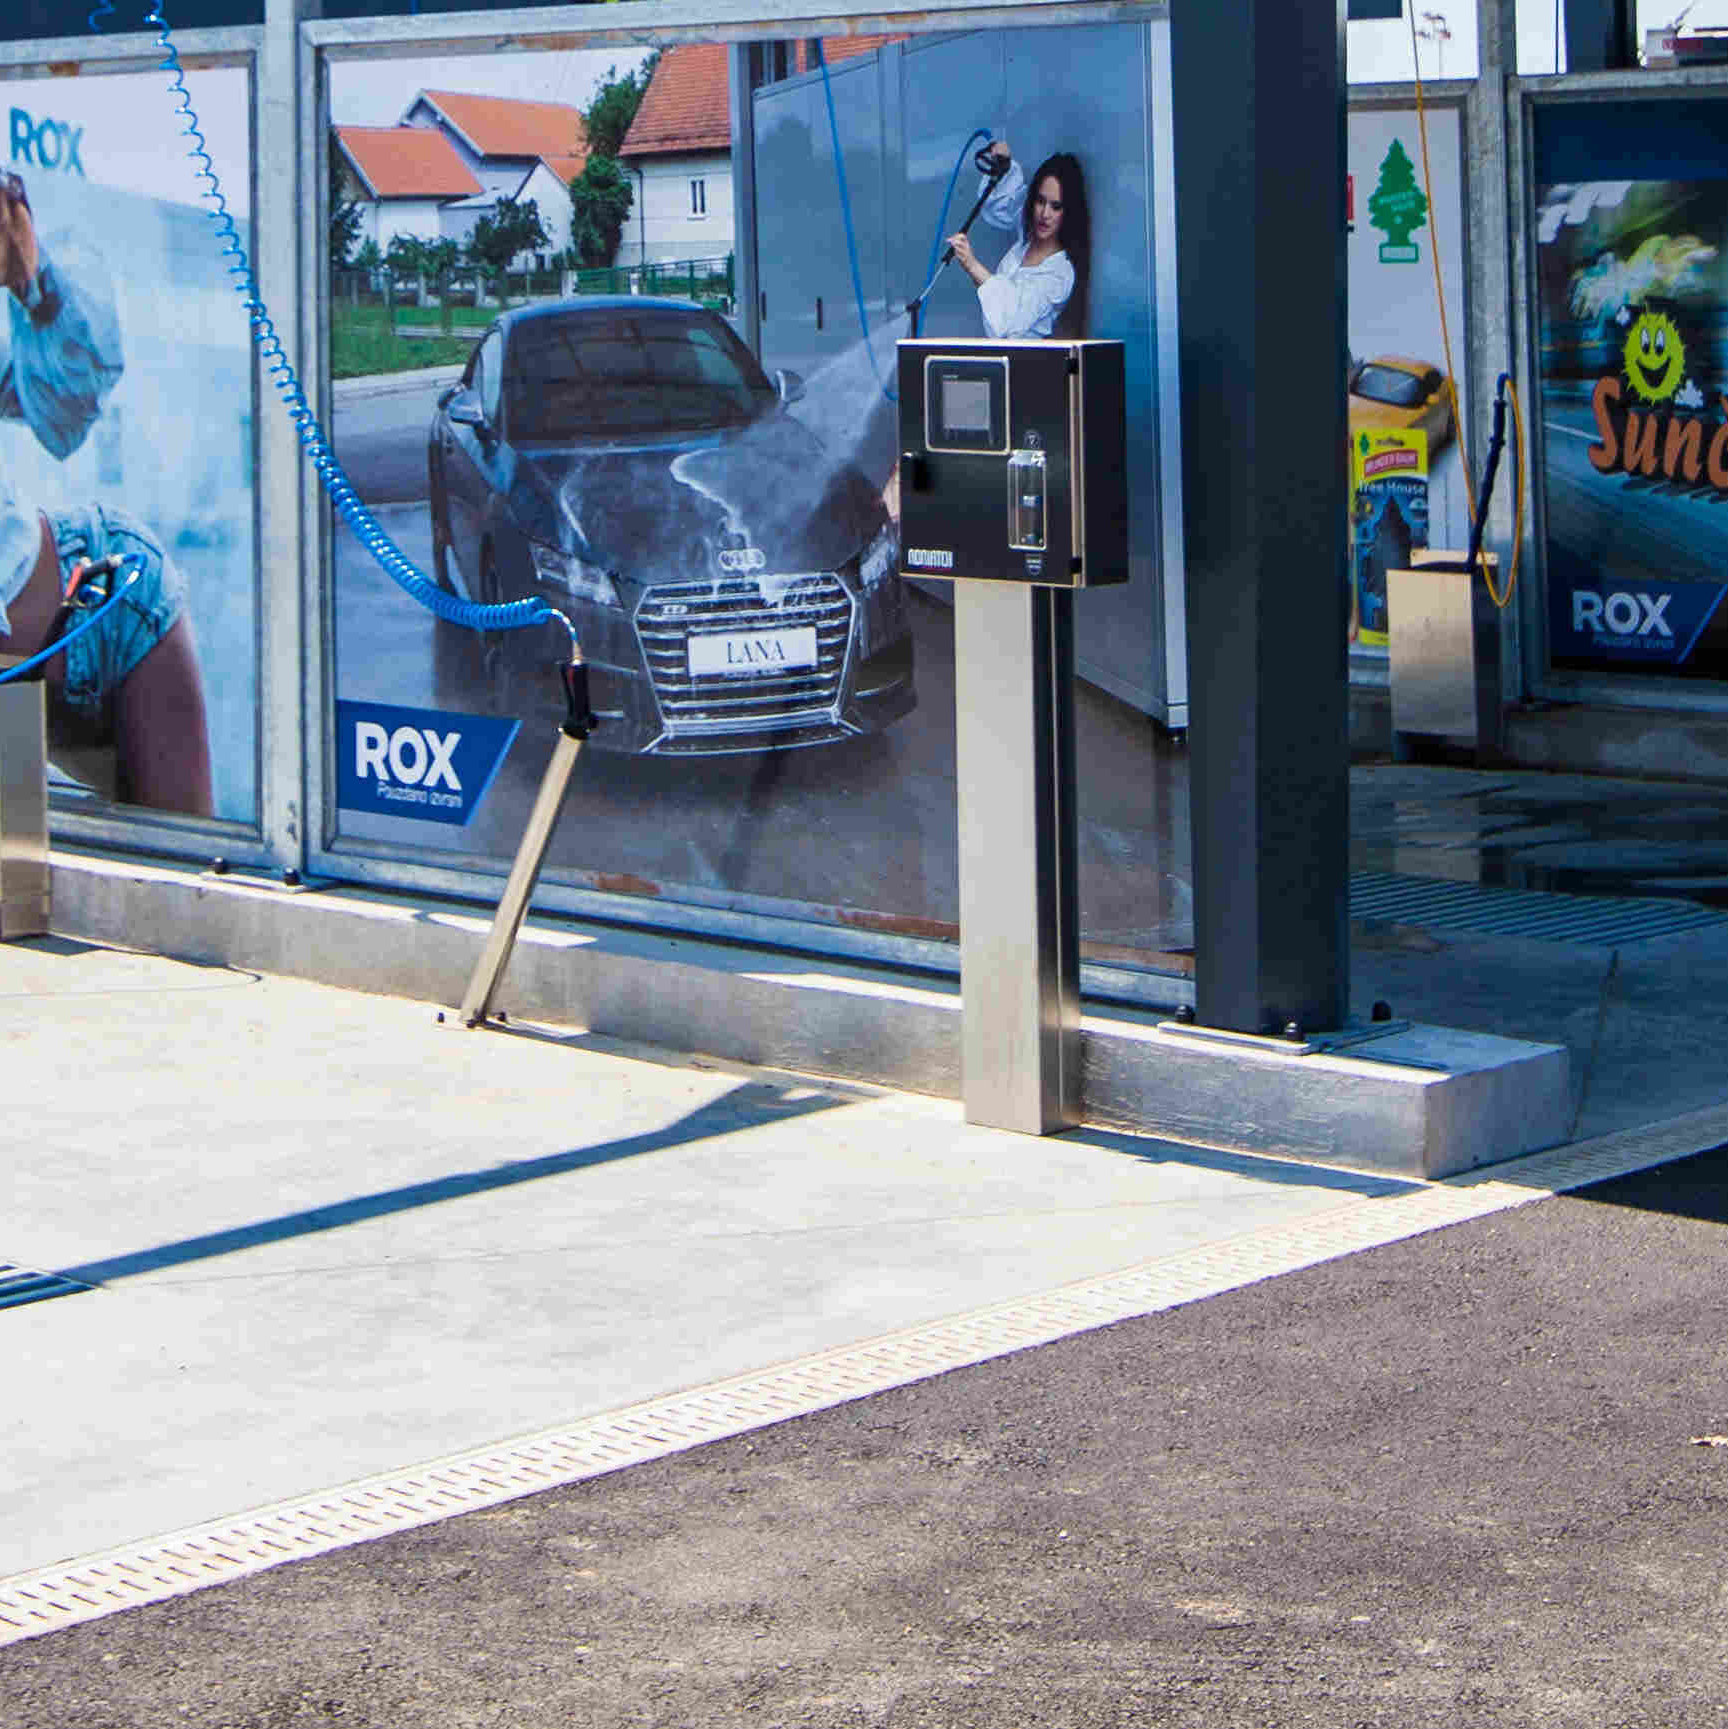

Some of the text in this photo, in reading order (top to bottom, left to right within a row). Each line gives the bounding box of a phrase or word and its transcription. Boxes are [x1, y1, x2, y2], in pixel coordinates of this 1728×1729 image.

[9, 106, 86, 179] ROX
[1572, 590, 1673, 637] ROX
[726, 639, 786, 664] LANA
[356, 721, 463, 791] ROX
